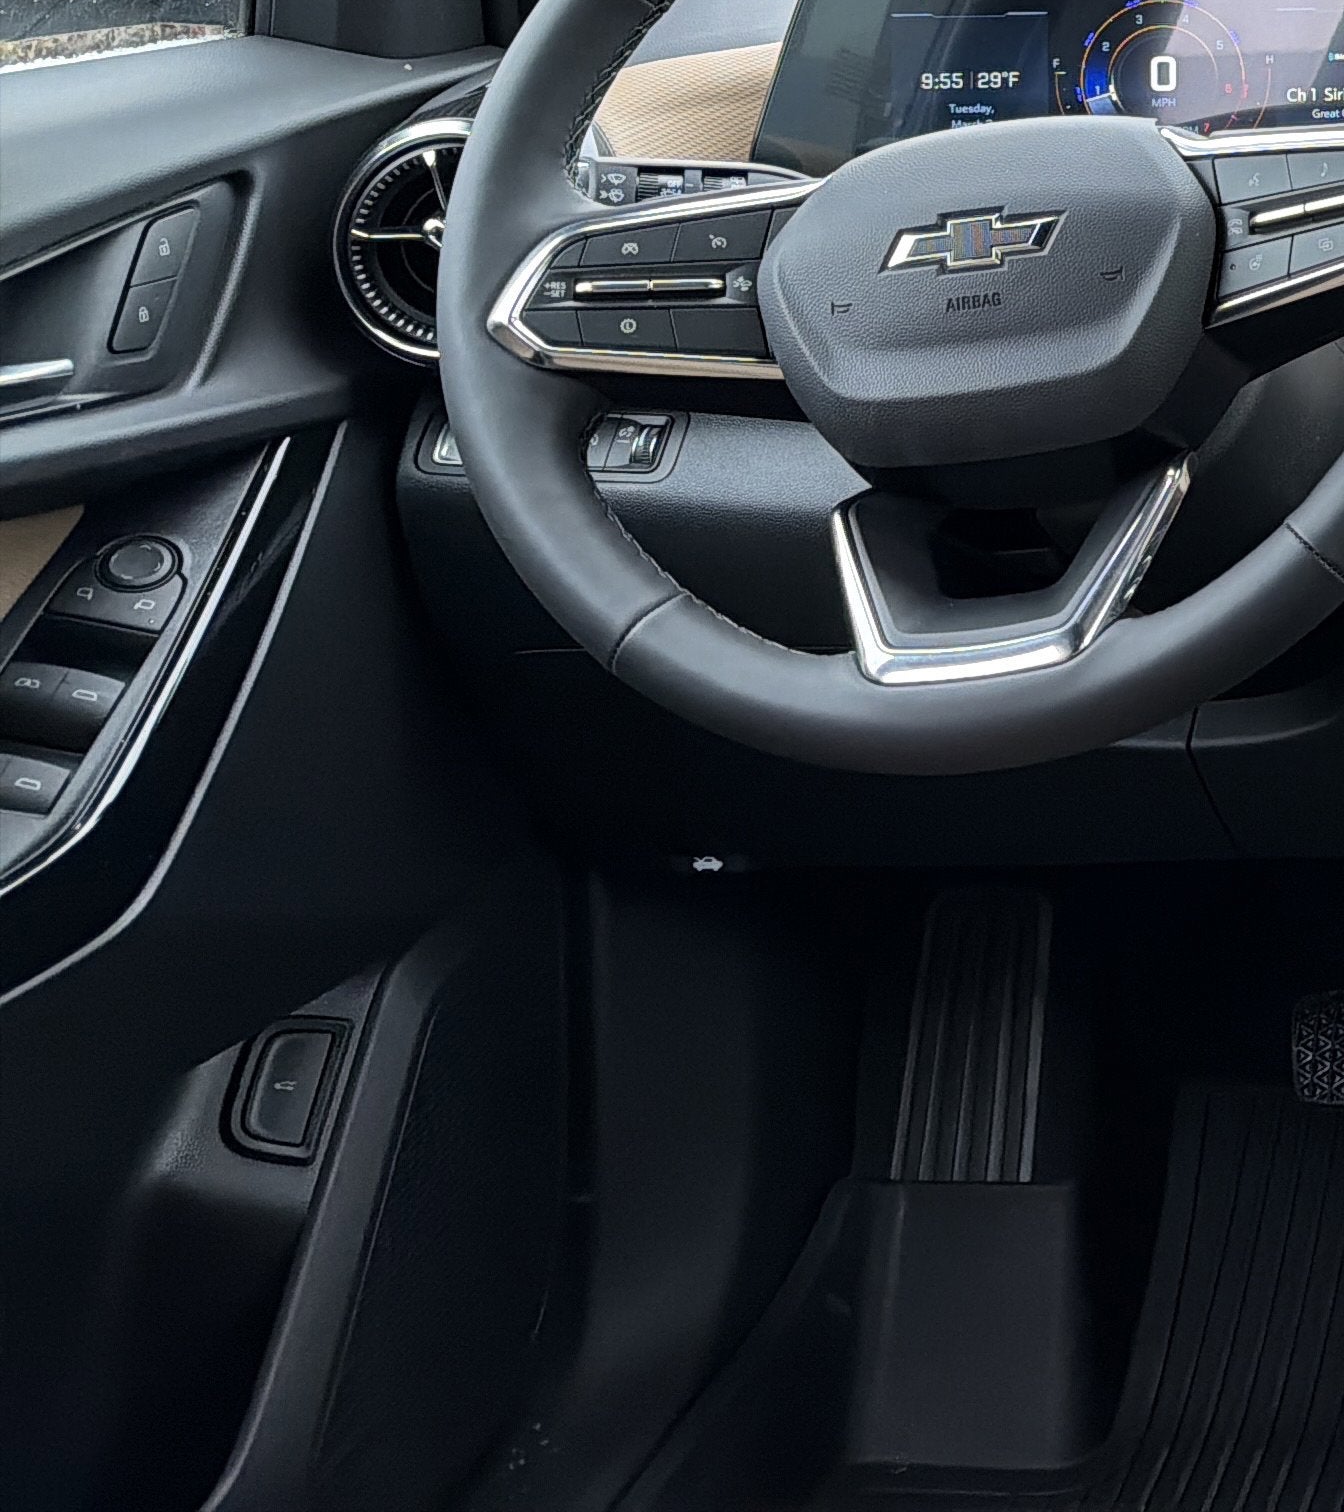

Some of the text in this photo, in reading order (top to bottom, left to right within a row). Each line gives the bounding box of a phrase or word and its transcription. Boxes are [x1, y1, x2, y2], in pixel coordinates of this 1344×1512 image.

[1135, 15, 1143, 26] 3
[1101, 42, 1111, 52] 2
[1265, 54, 1275, 65] H
[1150, 55, 1177, 92] 0
[920, 71, 1020, 90] 9:55 29°F
[1286, 87, 1307, 103] Ch
[1311, 87, 1317, 102] 1
[1151, 97, 1177, 108] MPH
[949, 103, 995, 116] Tuesday,
[1312, 108, 1340, 119] Great
[945, 292, 1002, 313] AIRBAG
